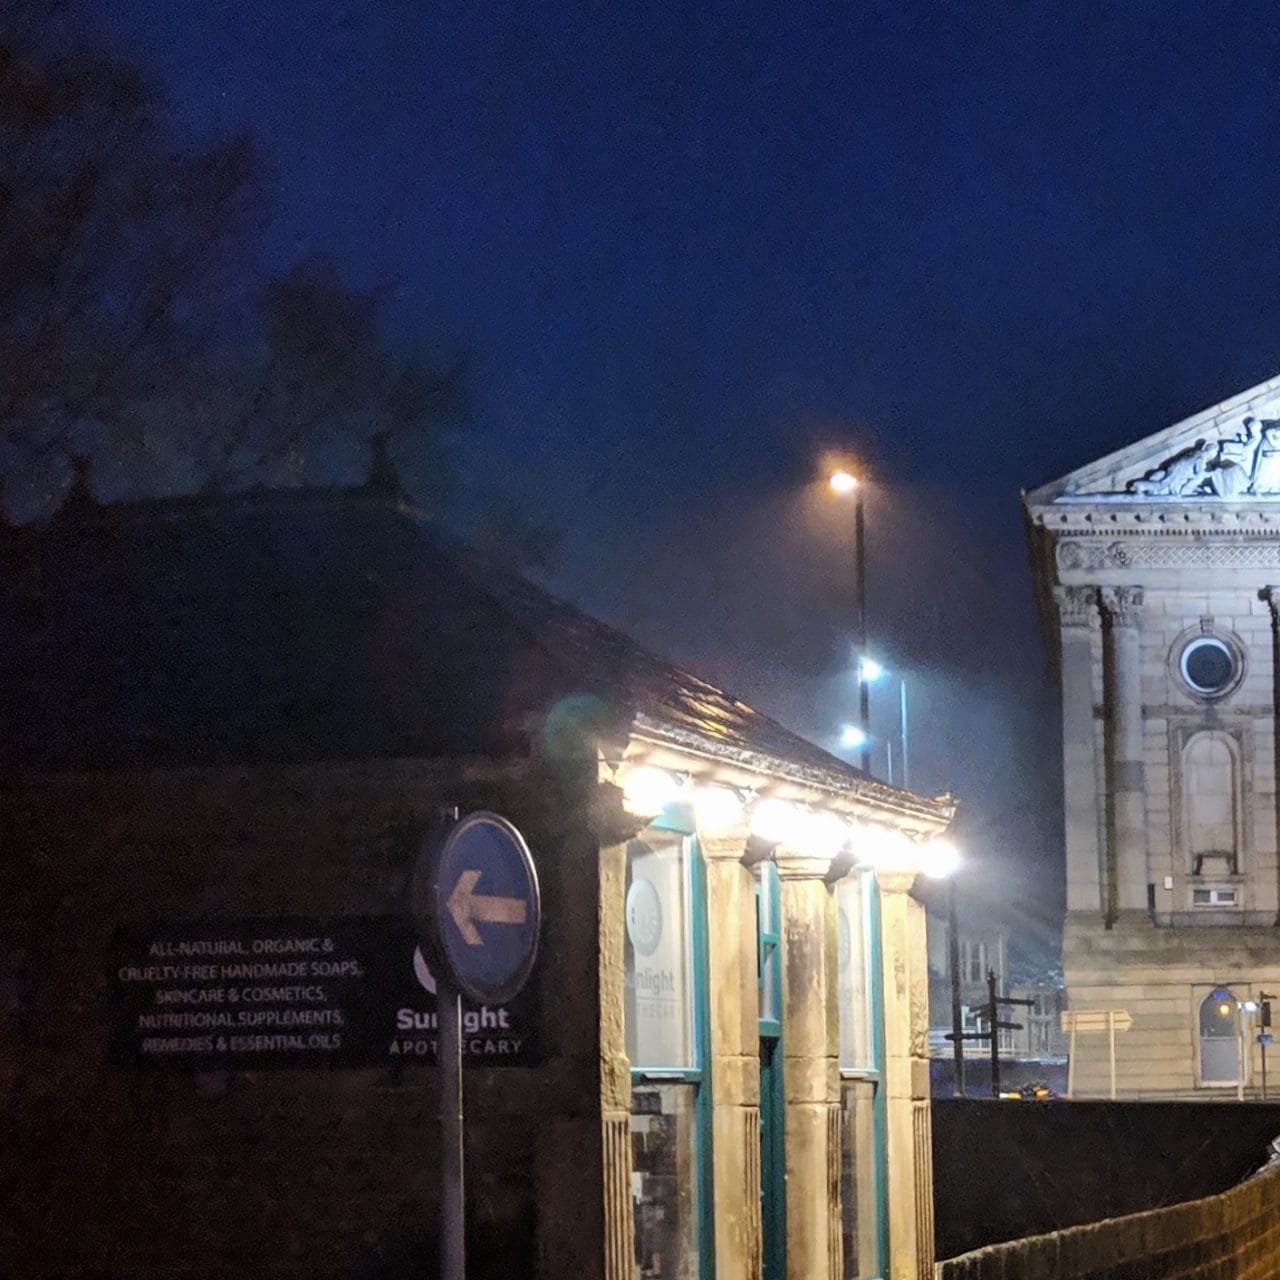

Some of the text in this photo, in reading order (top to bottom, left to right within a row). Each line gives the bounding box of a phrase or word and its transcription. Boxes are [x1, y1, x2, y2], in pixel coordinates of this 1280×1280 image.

[252, 938, 320, 954] ORGANIC
[321, 937, 335, 952] &
[118, 965, 219, 981] CRUELTY-FREE
[221, 962, 307, 978] HANDMADE
[156, 988, 225, 1004] SKINCARE
[227, 987, 240, 1002] &
[139, 1012, 235, 1029] NUTRITIONAL
[215, 1036, 228, 1051] &
[230, 1034, 306, 1052] ESSENTIAL
[309, 1034, 341, 1050] OILS
